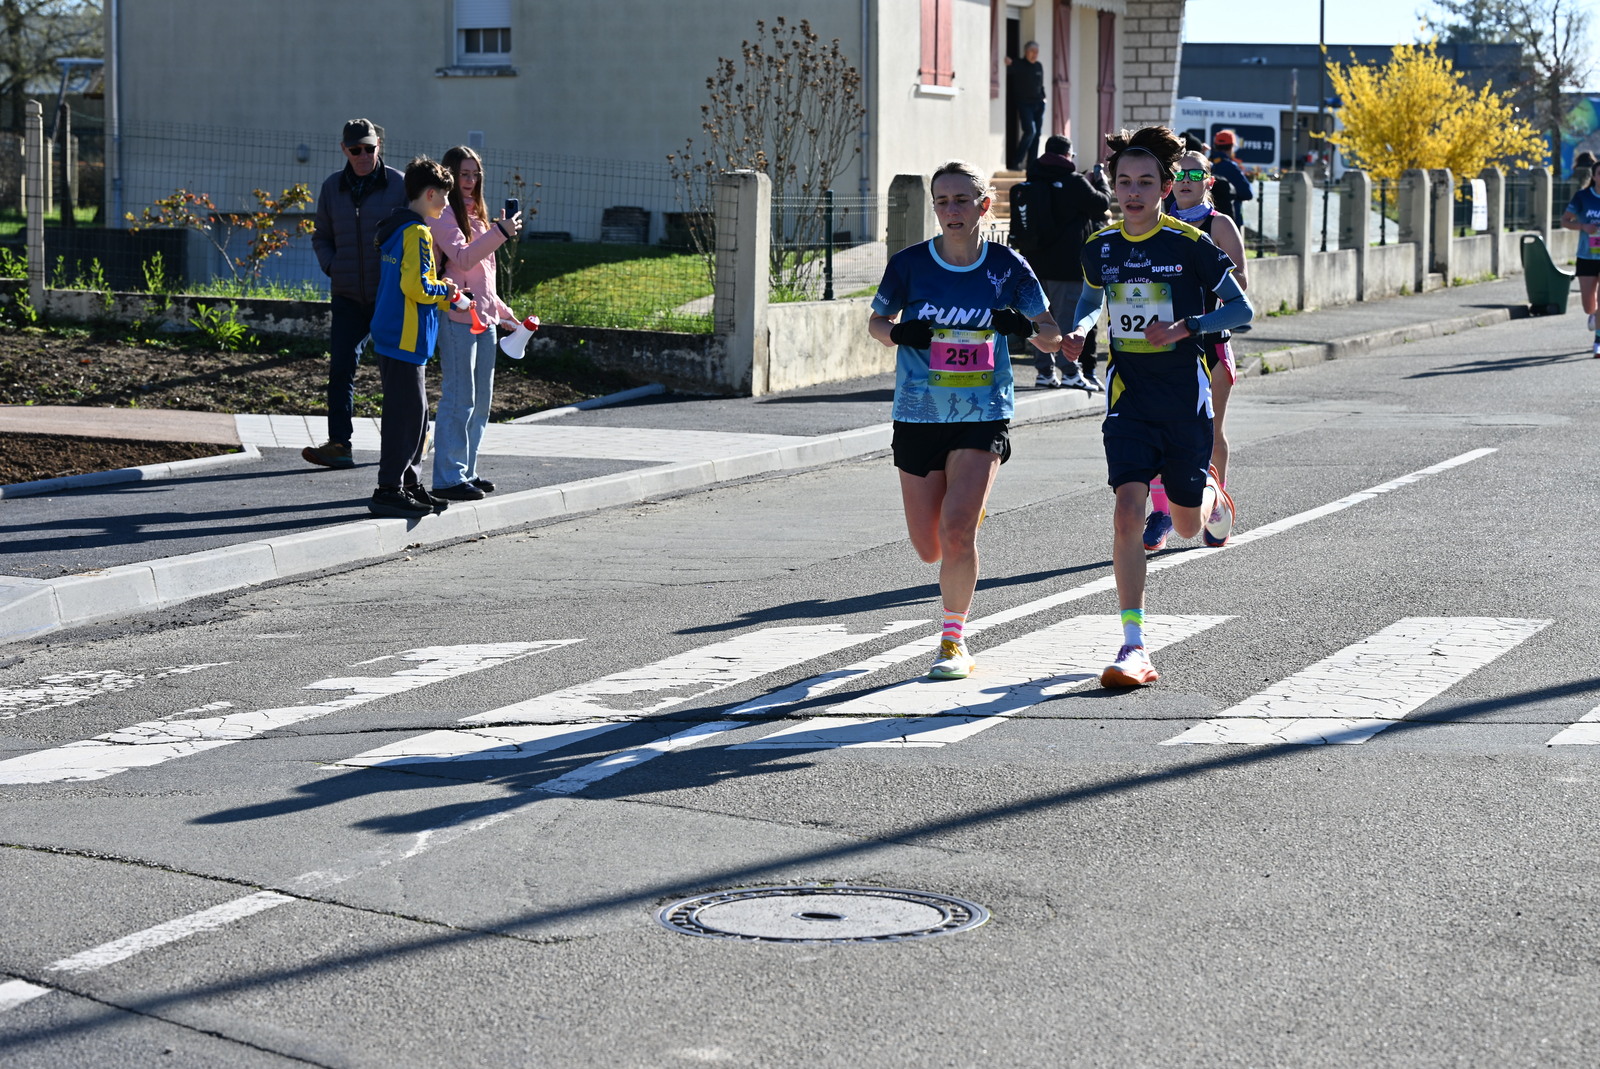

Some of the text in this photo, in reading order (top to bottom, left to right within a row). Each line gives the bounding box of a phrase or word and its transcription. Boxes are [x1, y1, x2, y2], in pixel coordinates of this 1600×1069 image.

[1227, 110, 1236, 118] LA
[1239, 111, 1264, 119] SARTHE
[1263, 141, 1273, 151] 72
[1151, 265, 1174, 273] SUPER
[917, 302, 993, 328] RUN'I
[1121, 314, 1159, 332] 924
[945, 348, 978, 366] 251
